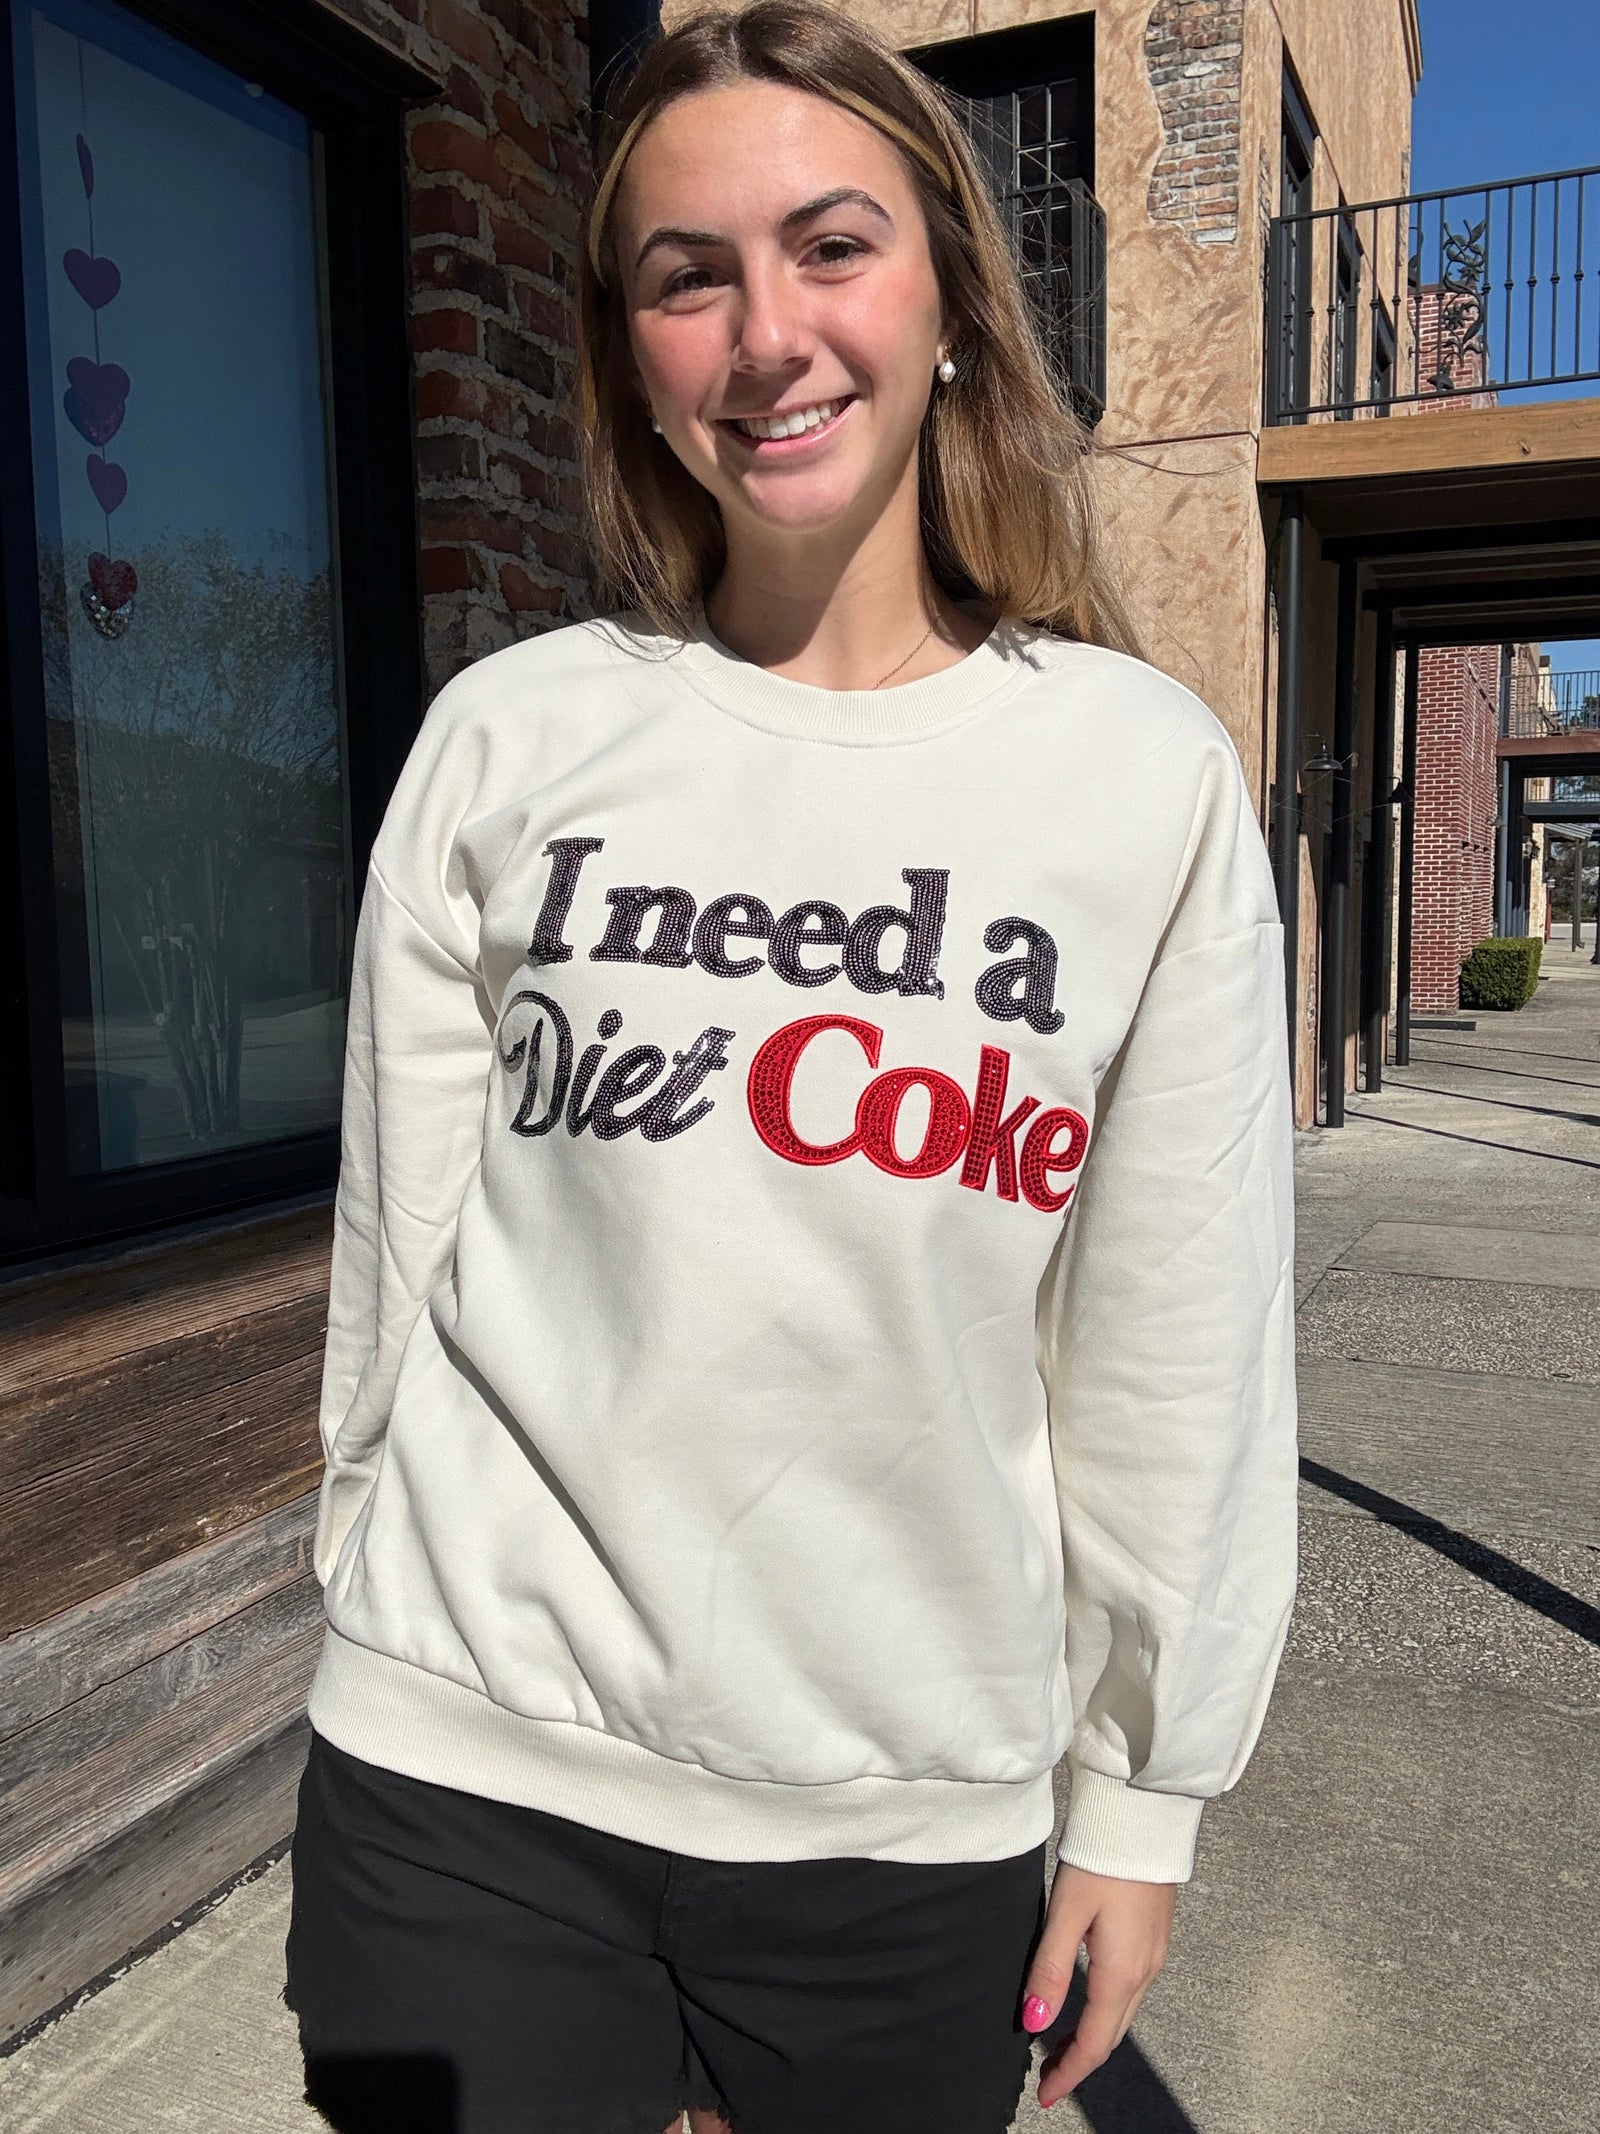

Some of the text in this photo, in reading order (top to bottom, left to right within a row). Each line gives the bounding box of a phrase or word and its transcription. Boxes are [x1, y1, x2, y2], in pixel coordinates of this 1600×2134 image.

[527, 837, 1066, 1035] I need a
[500, 989, 1089, 1214] Diet Coke
